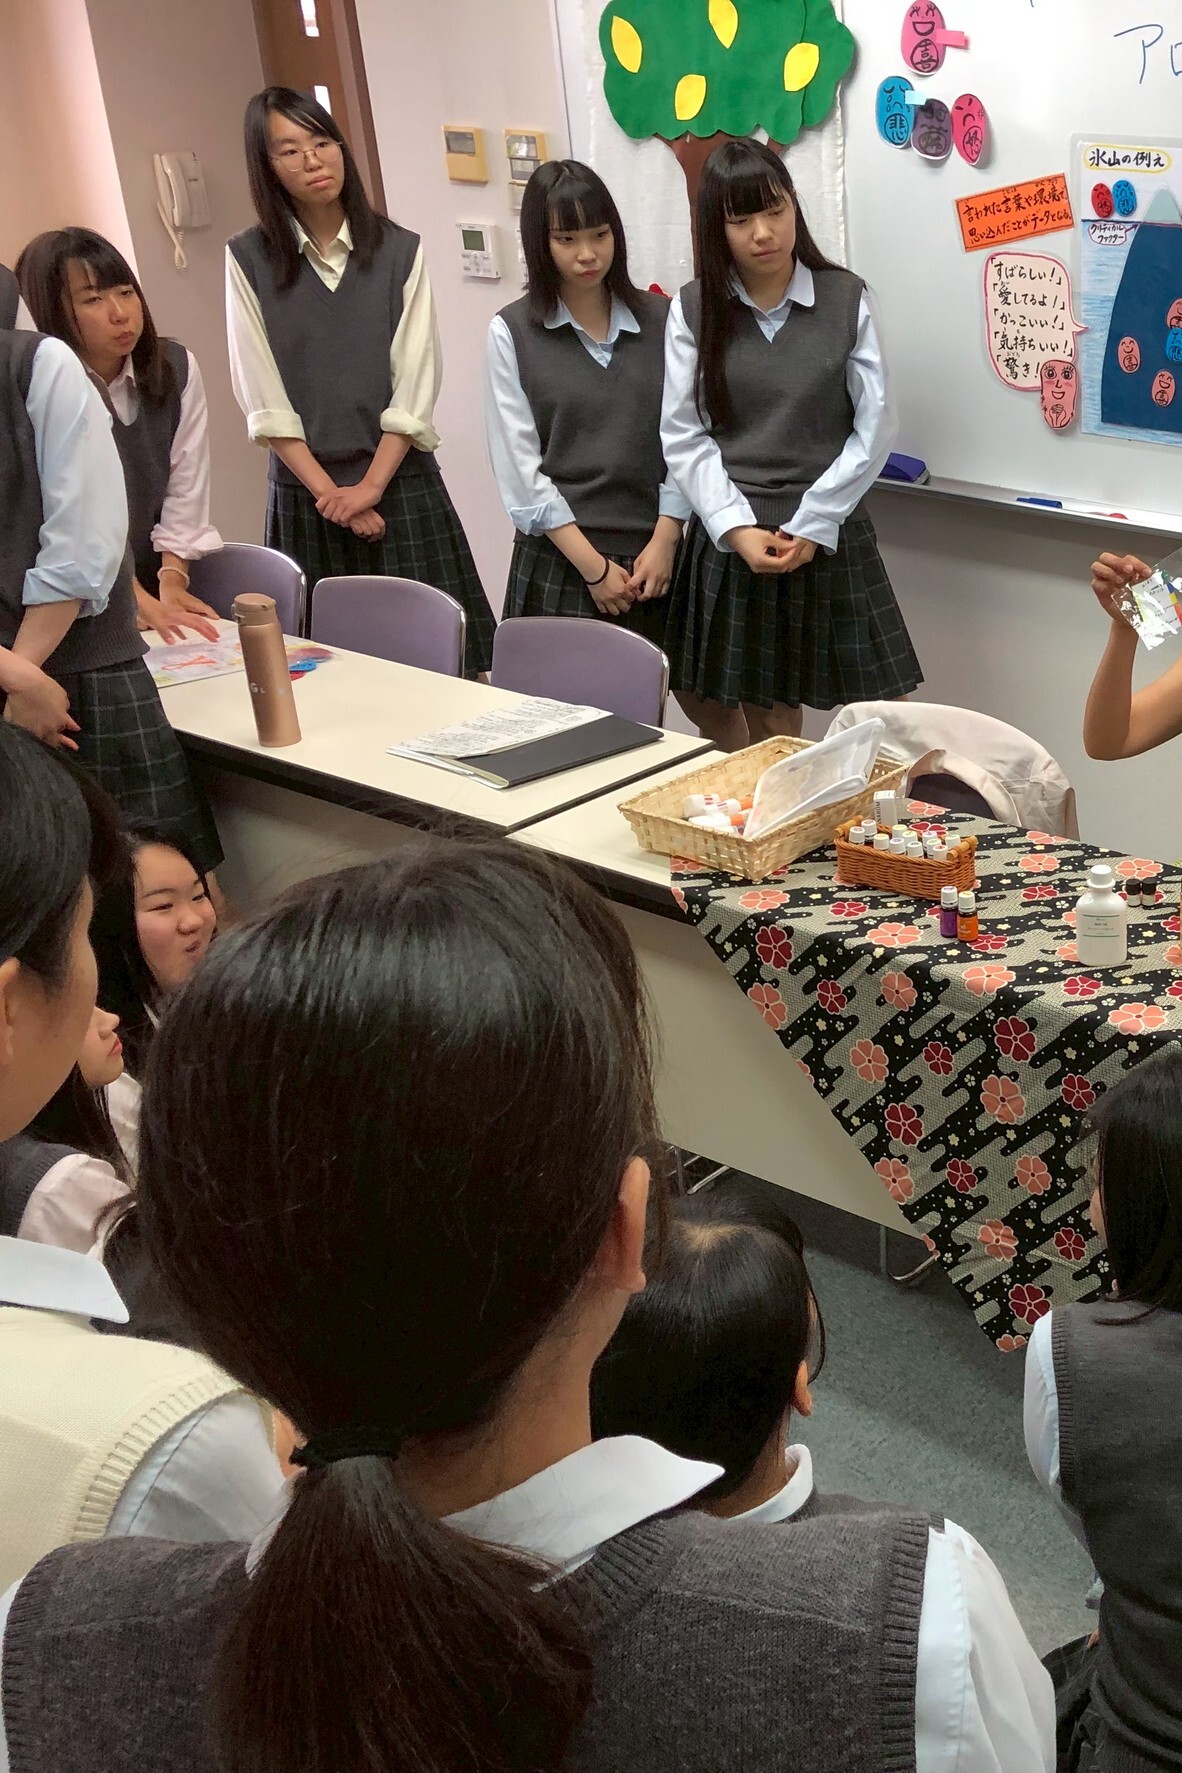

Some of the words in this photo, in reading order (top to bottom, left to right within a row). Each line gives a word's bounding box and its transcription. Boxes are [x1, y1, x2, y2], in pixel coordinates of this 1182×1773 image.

[1089, 148, 1165, 168] 氷山の例え
